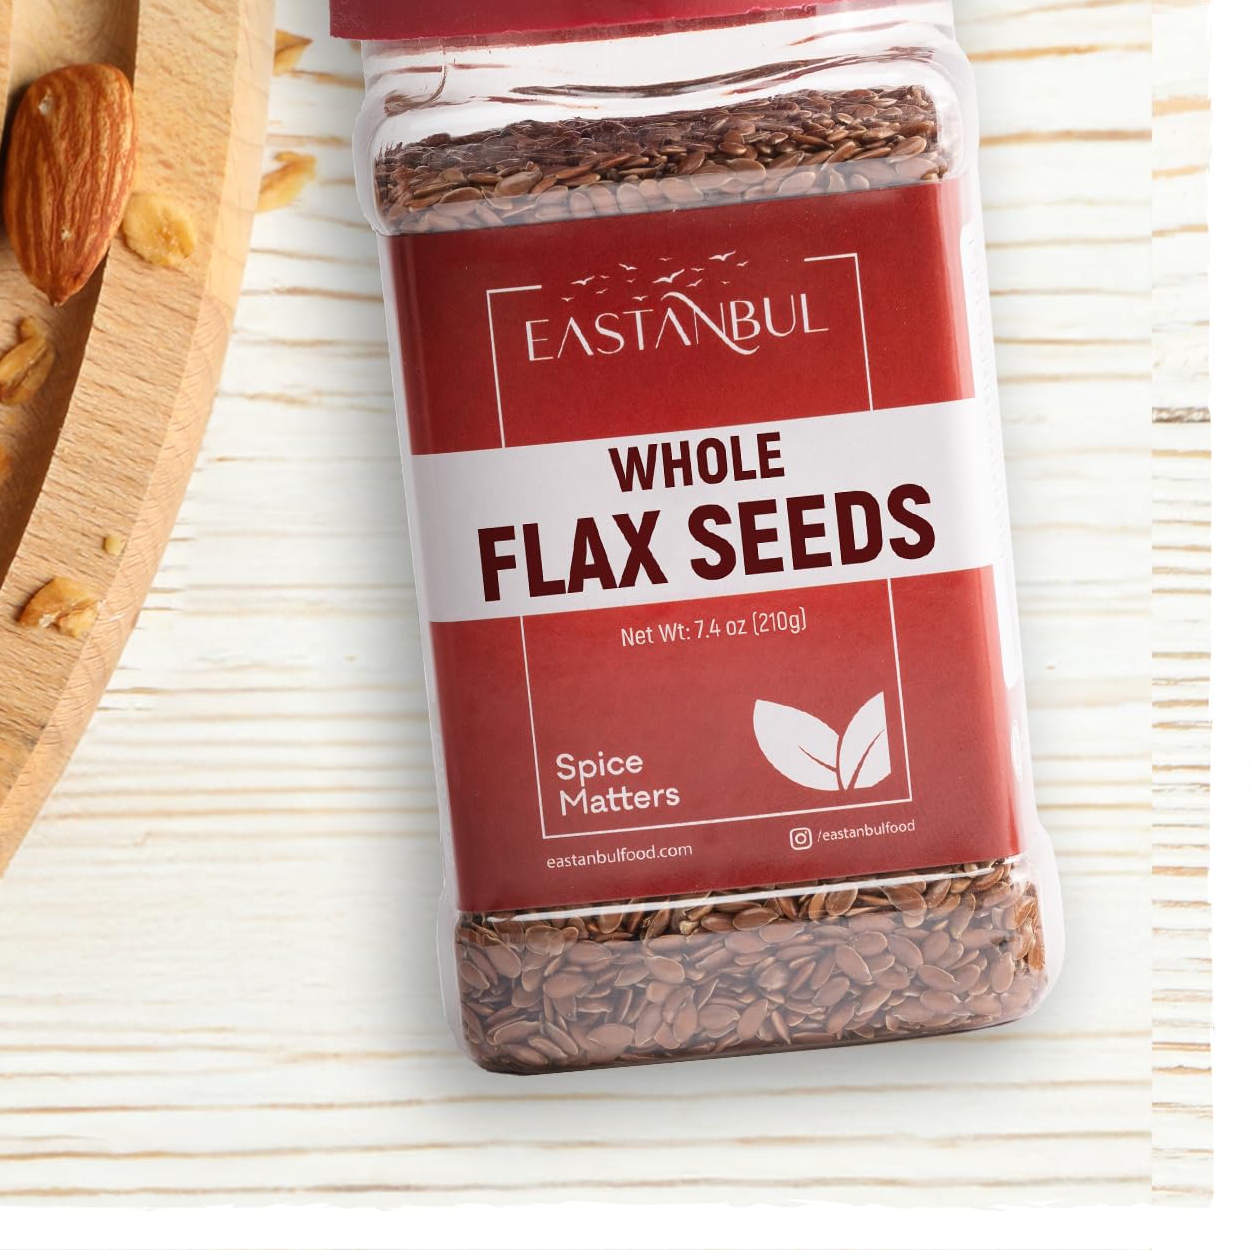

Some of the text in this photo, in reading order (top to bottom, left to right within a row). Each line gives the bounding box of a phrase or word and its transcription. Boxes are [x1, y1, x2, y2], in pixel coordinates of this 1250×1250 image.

[525, 291, 829, 362] EASTANBUL
[609, 431, 785, 493] WHOLE
[477, 483, 936, 603] FLAX SEEDS
[620, 626, 655, 647] Net
[658, 622, 691, 643] Wt:
[694, 618, 721, 639] 7.4
[725, 619, 748, 636] oz
[555, 751, 644, 787] Spice
[559, 784, 680, 816] Matters
[817, 818, 916, 843] /eastanbulfood
[546, 844, 693, 869] eastanbulfood.com
